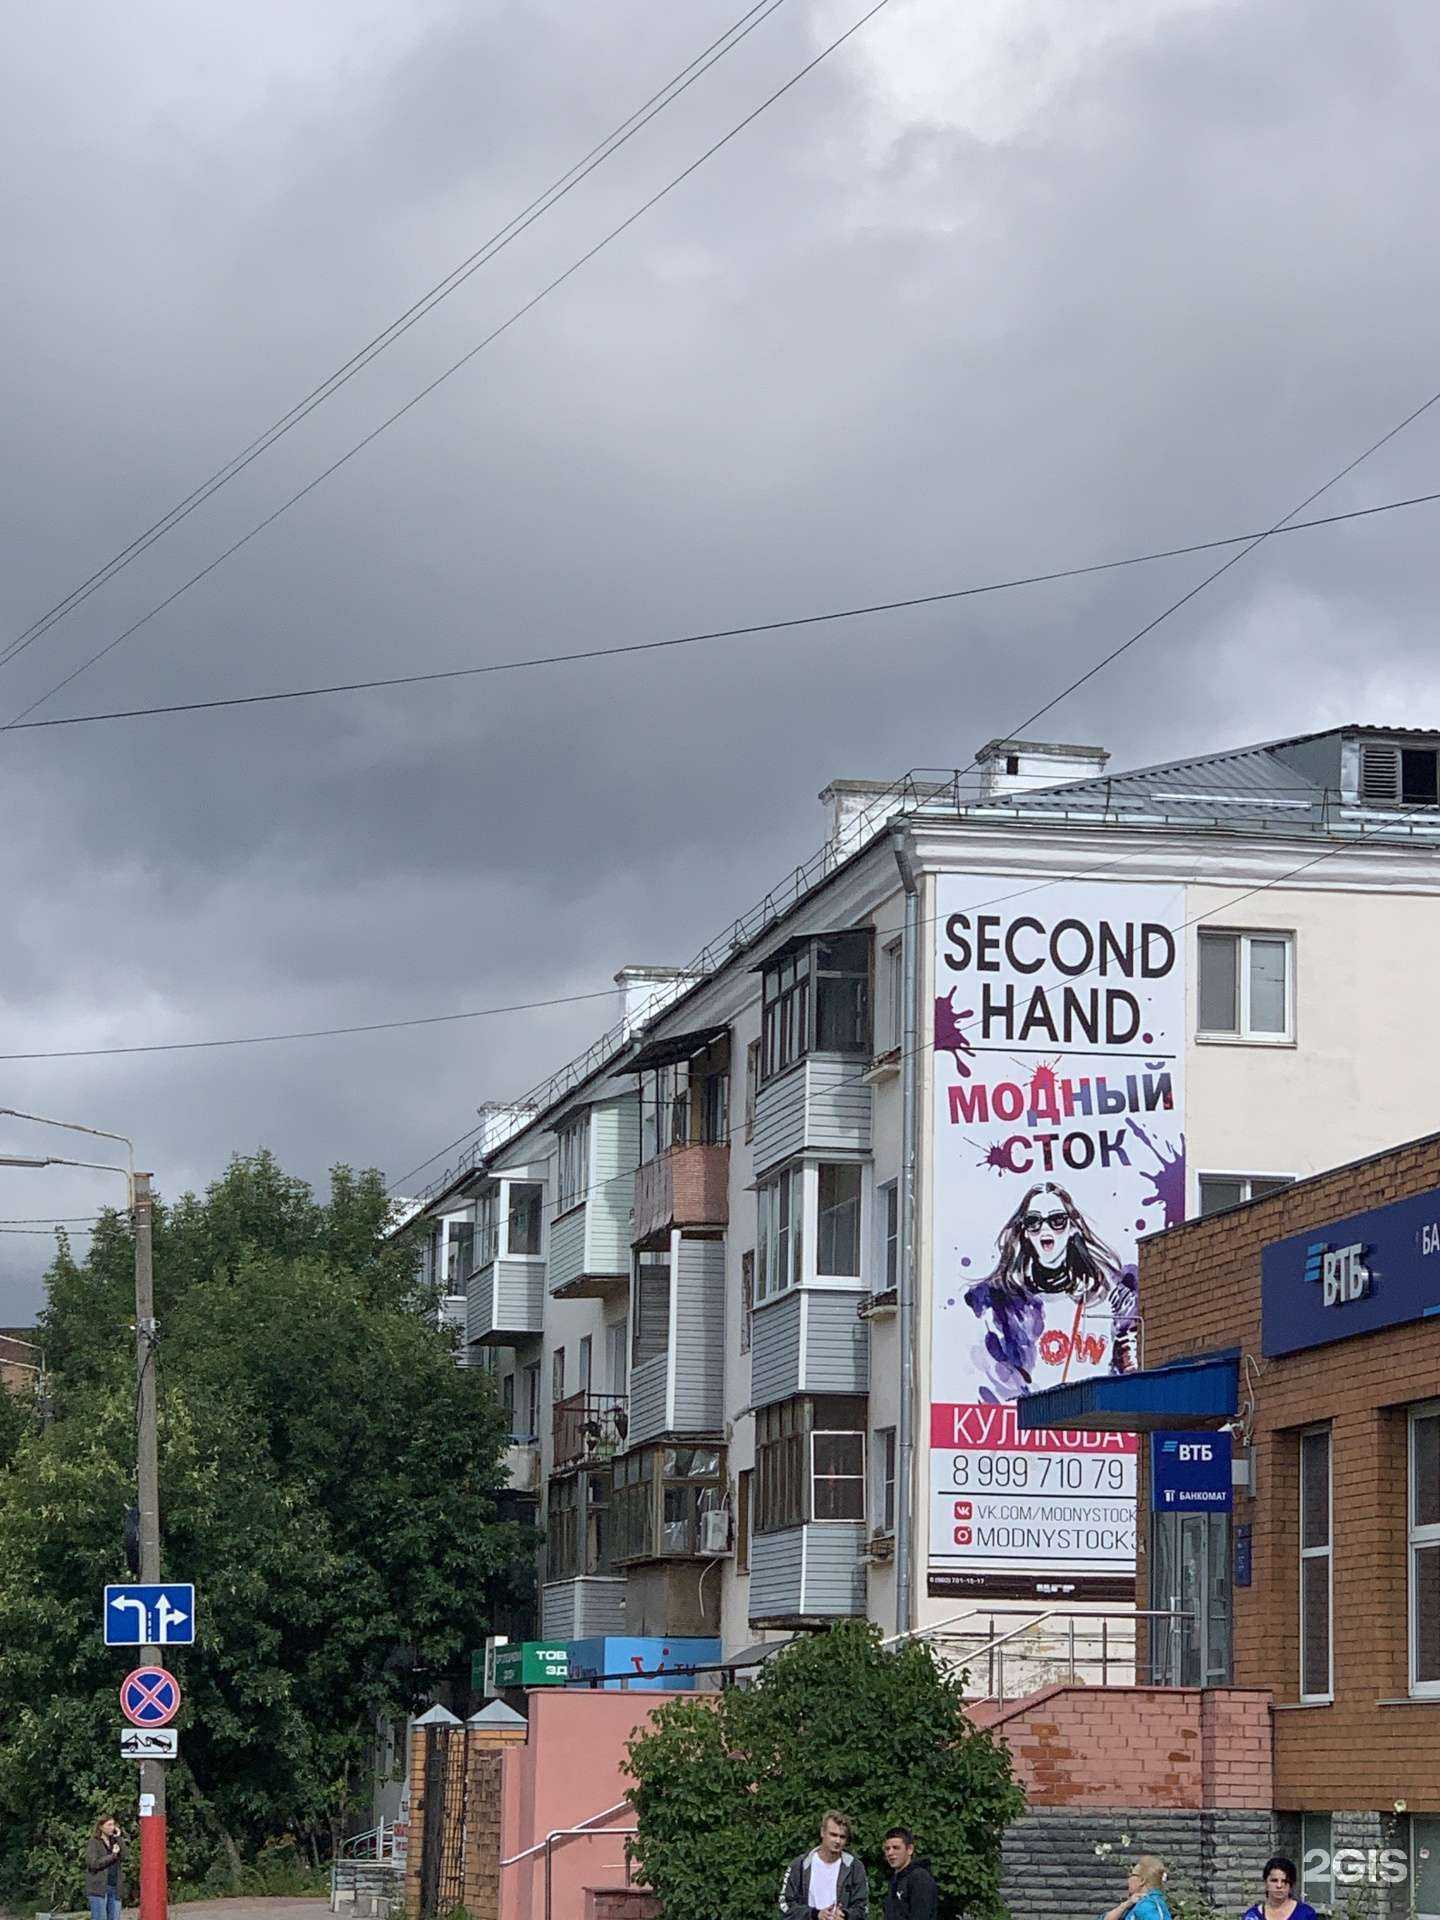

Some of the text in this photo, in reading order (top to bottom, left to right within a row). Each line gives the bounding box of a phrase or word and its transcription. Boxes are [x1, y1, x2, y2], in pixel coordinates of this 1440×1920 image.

[944, 914, 1176, 979] SECOND
[948, 1061, 1174, 1127] МОДНЫЙ
[1001, 1129, 1132, 1174] СТОК
[1323, 1243, 1367, 1307] ВТБ
[953, 1455, 1124, 1490] 8 999 710 79
[1179, 1444, 1213, 1461] ВТБ
[1180, 1491, 1227, 1501] БАНКОМАТ
[536, 1650, 568, 1661] ТОВ
